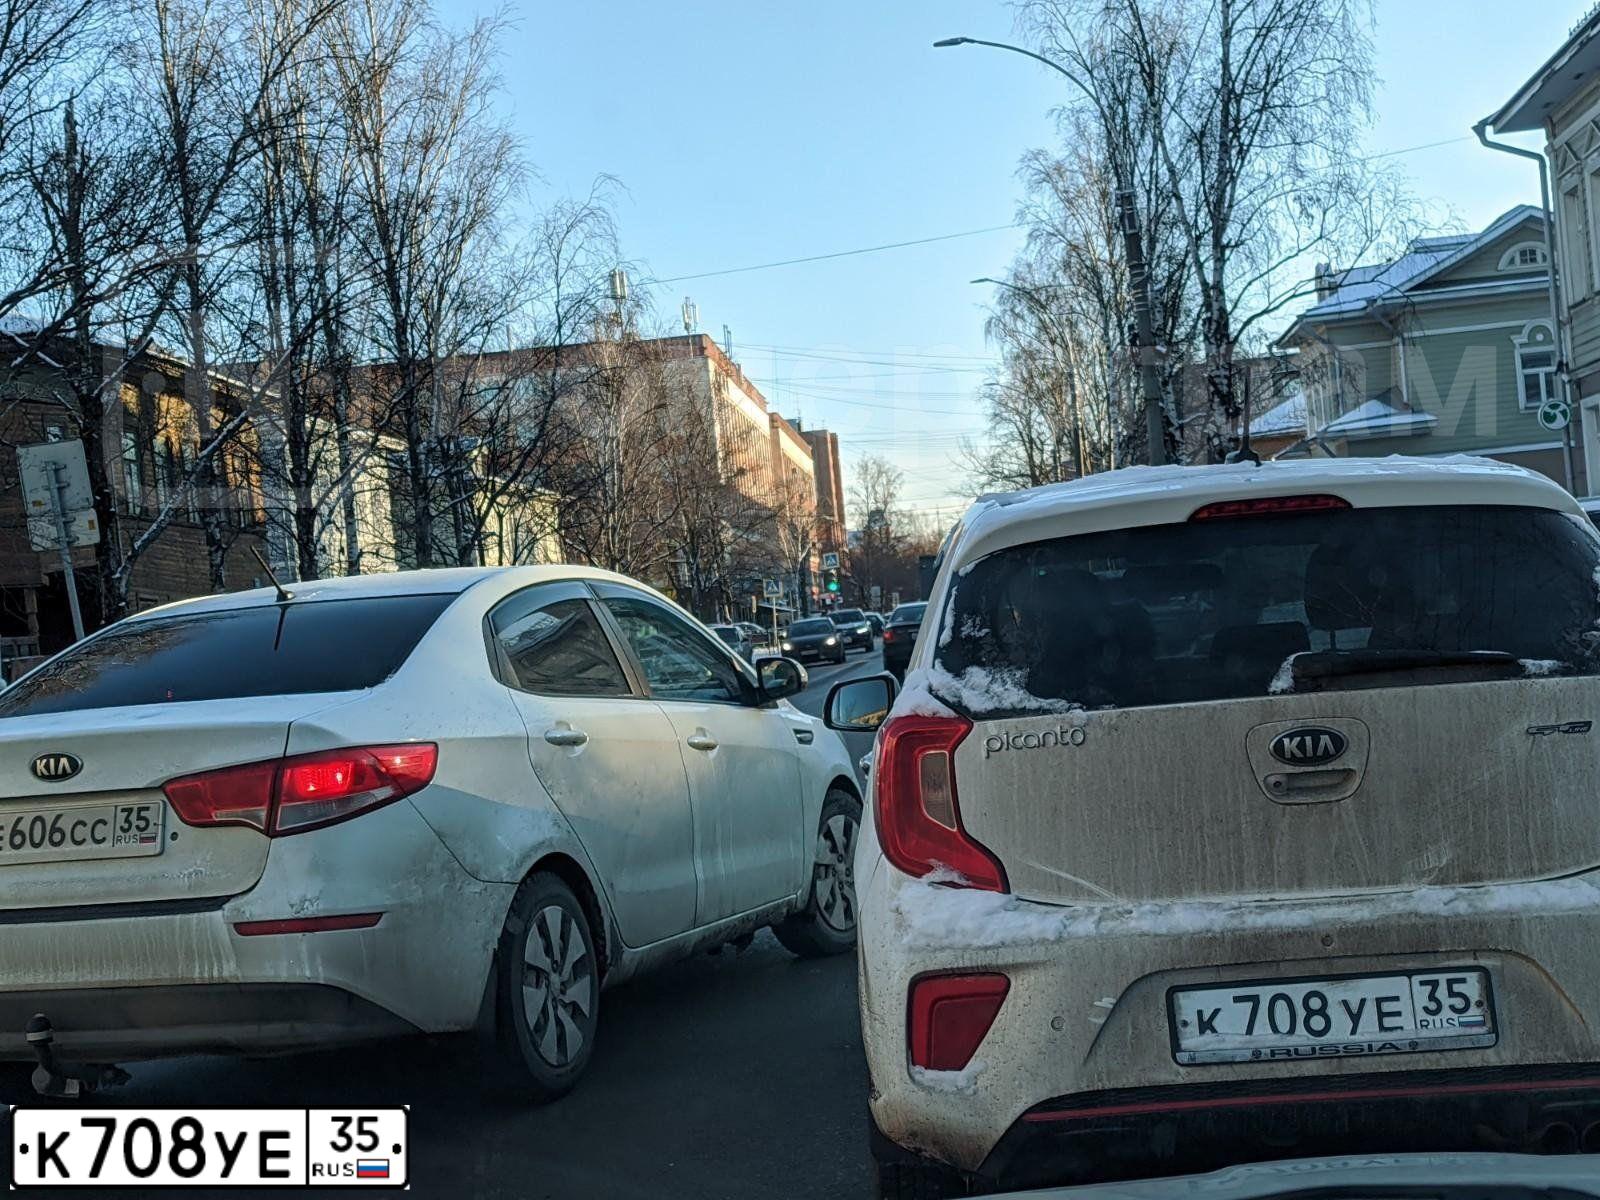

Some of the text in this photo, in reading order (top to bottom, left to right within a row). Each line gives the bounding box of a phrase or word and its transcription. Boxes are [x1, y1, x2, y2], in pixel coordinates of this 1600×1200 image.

[984, 726, 1086, 759] picanto
[1282, 734, 1337, 760] KIA
[35, 758, 72, 776] KIA
[119, 806, 150, 834] 35
[116, 833, 138, 845] RUS
[1196, 977, 1472, 1037] К708УЕ 35
[1419, 1016, 1457, 1031] RUS
[1269, 1041, 1401, 1059] RUSSIA
